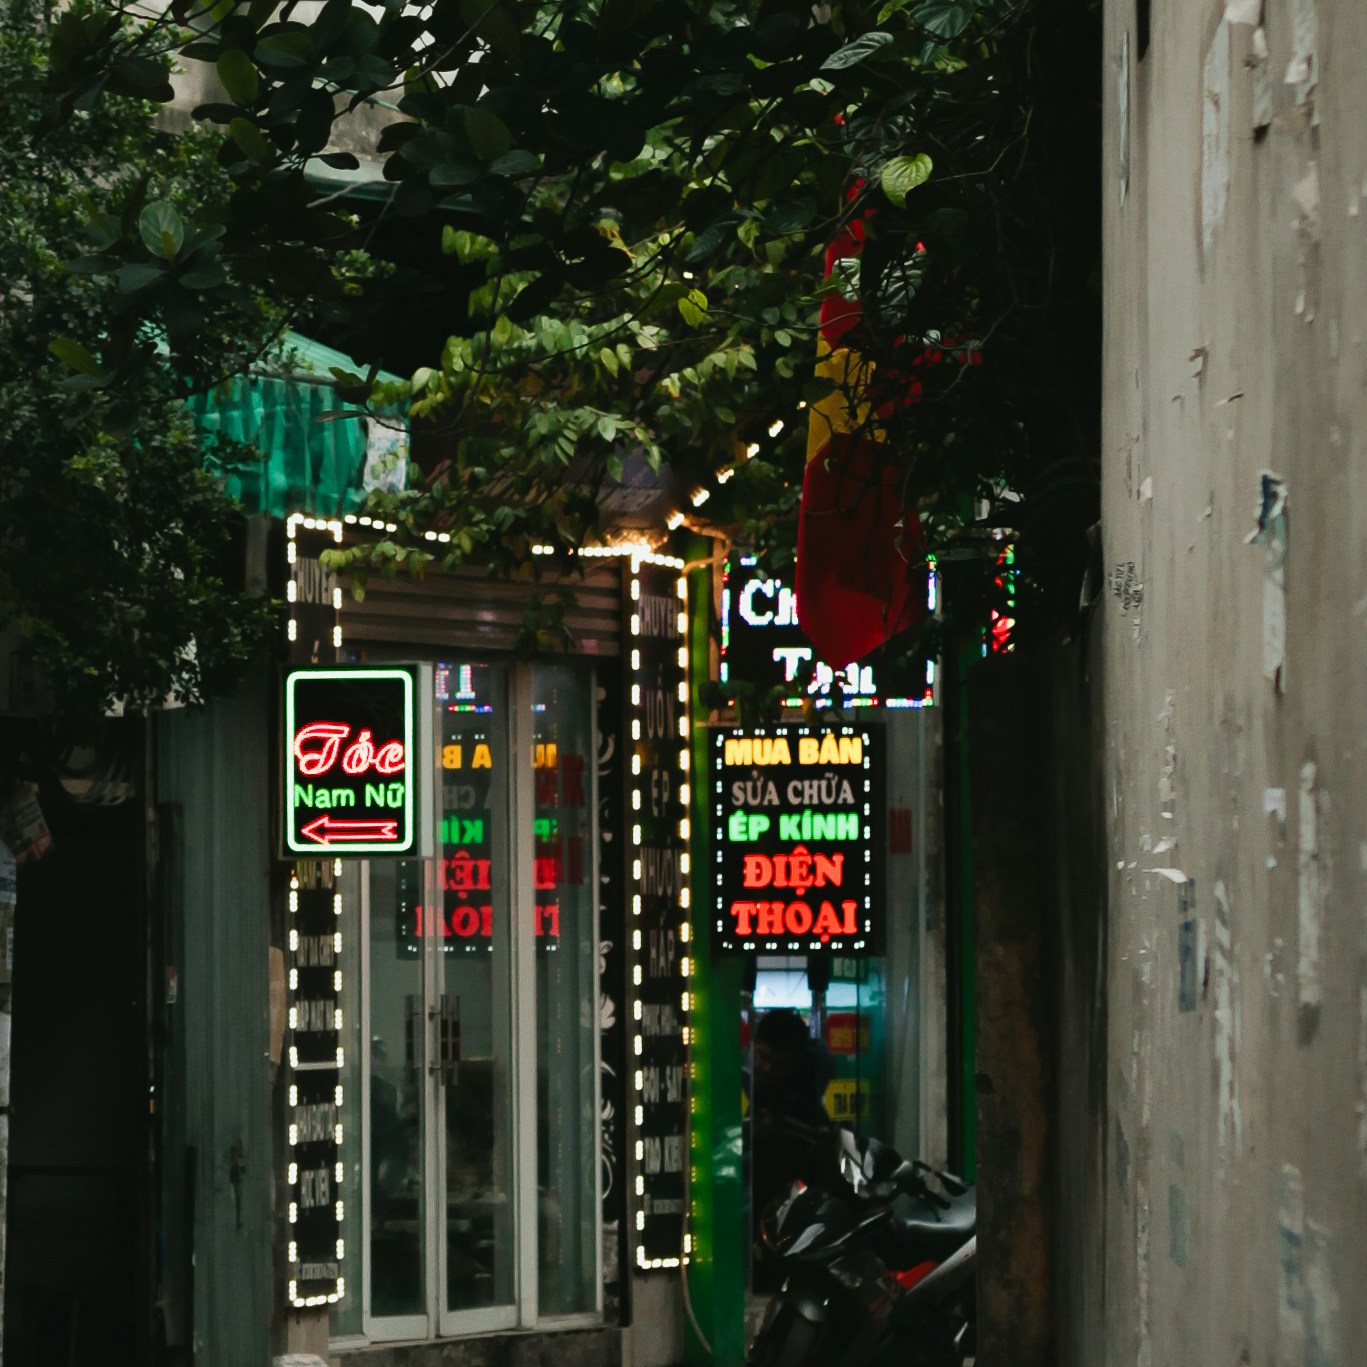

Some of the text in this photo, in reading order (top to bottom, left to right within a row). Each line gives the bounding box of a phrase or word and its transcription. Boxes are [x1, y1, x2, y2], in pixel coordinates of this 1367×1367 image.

[293, 721, 406, 776] Tóc
[725, 732, 863, 765] MUA BÁN
[294, 783, 405, 809] Nam Nữ
[732, 770, 855, 806] SỬA CHỮA
[728, 809, 770, 842] ÉP
[779, 809, 860, 841] KÍNH
[743, 844, 845, 896] ĐIỆN
[731, 900, 858, 943] THOẠI
